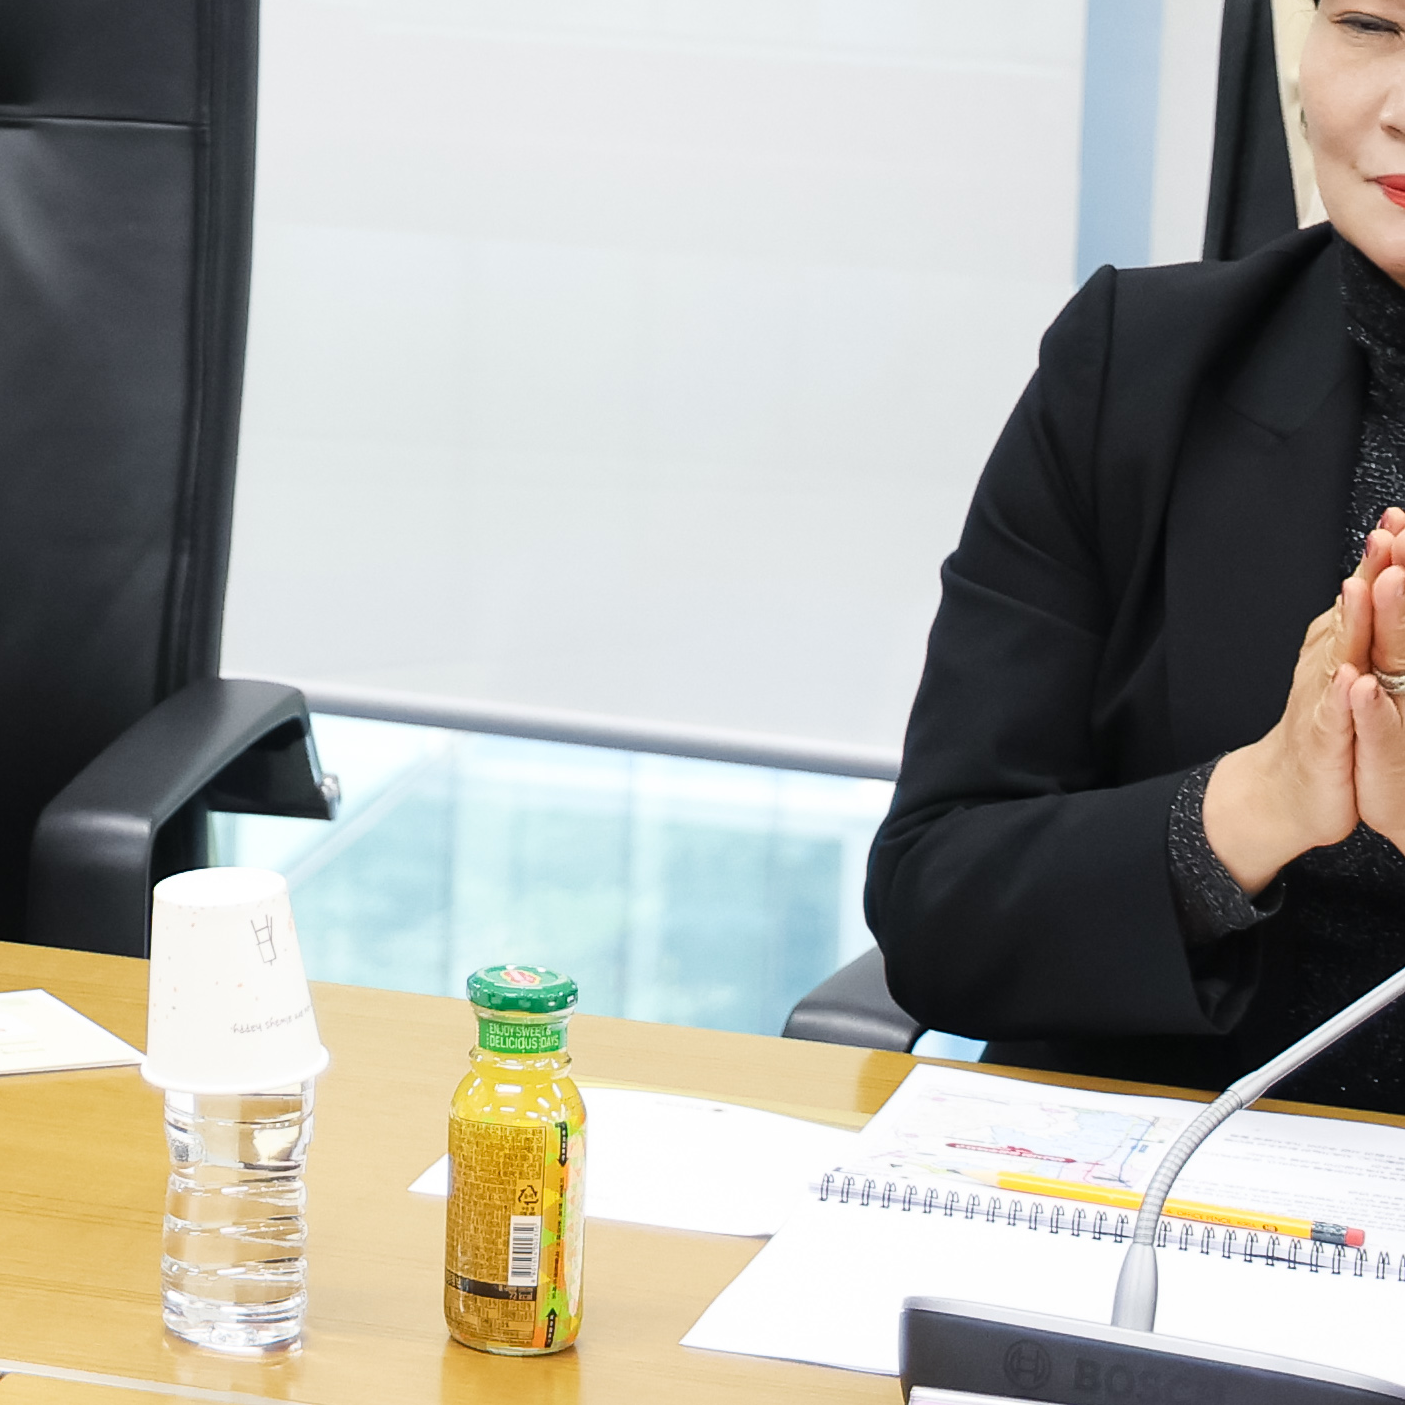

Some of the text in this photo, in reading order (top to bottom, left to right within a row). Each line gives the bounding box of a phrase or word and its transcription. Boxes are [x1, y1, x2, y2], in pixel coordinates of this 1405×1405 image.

[489, 1022, 514, 1036] ENJOY
[515, 1025, 545, 1038] SWEET
[489, 1034, 559, 1050] DELICIOUS DAYS
